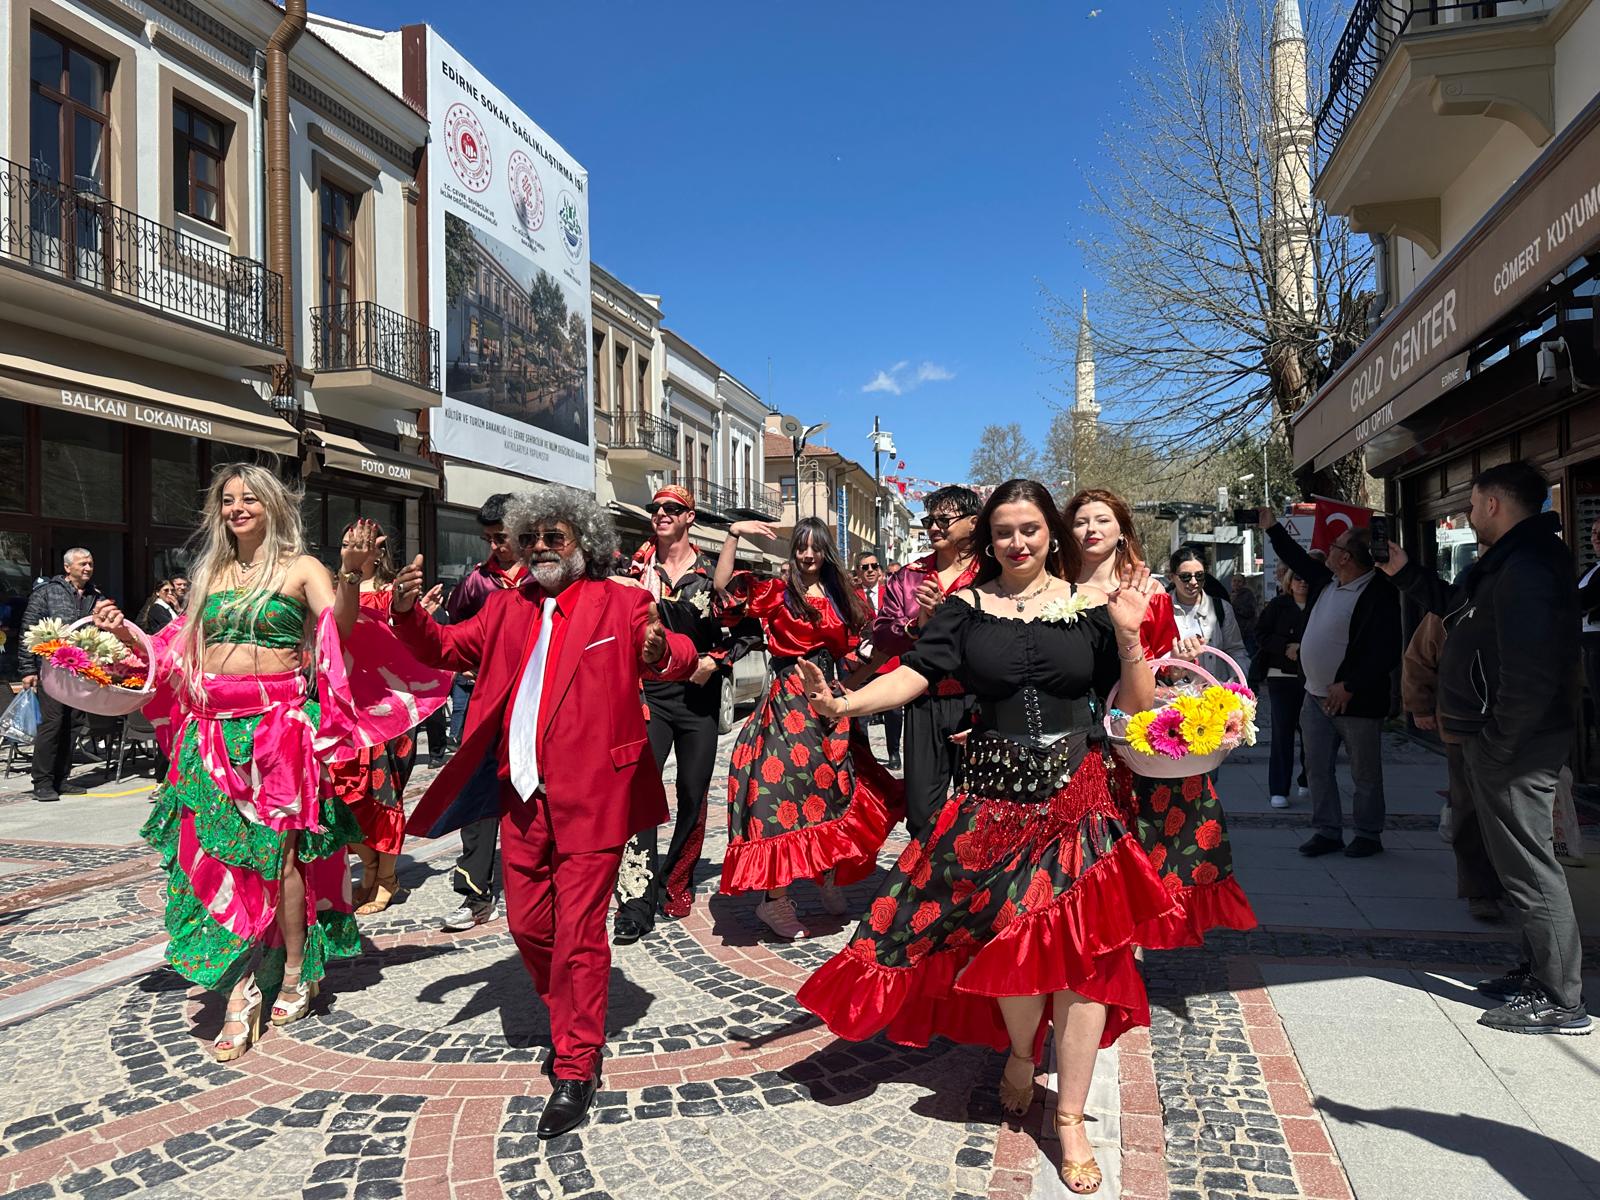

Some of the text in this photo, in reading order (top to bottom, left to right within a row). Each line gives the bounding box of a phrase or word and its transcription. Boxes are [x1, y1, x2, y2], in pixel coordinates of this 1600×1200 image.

[441, 60, 479, 102] EDİRNE
[480, 93, 511, 129] SOKAK
[512, 120, 574, 185] SAĞLIKLAŞTIRMA
[574, 174, 583, 194] İŞİ
[1493, 236, 1541, 296] CÖMERT
[1350, 288, 1457, 413] GOLD CENTER
[61, 389, 212, 435] BALKAN LOKANTASI
[361, 459, 411, 480] FOTO OZAN
